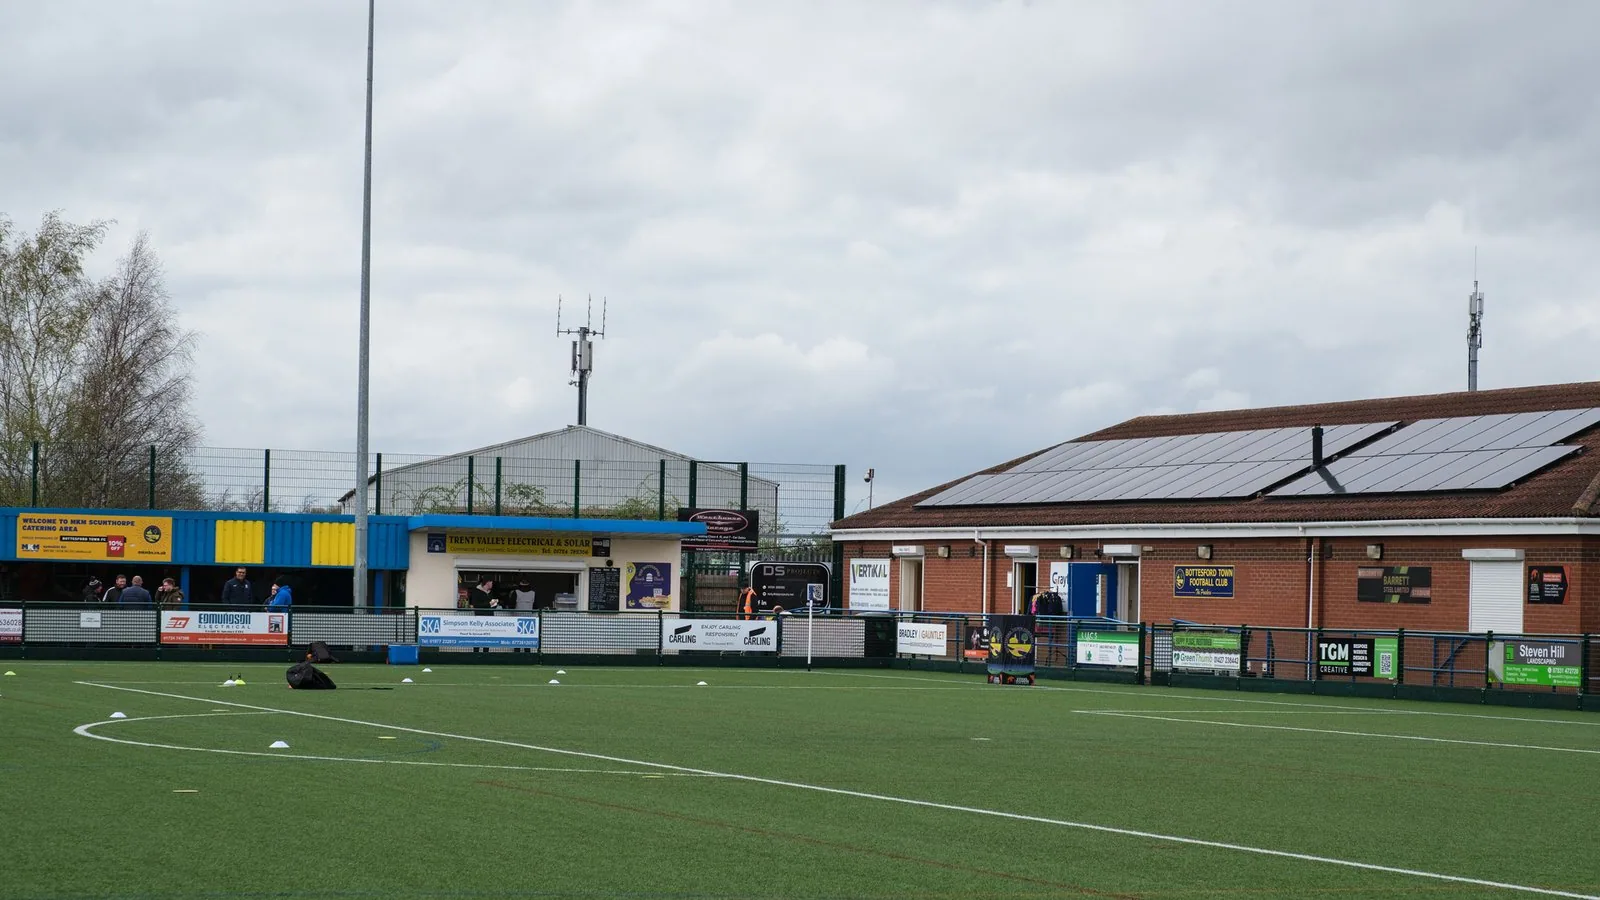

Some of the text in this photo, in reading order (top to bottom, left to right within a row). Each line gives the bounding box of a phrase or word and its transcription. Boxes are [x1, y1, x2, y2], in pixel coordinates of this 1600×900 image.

[449, 536, 475, 544] TRENT
[477, 536, 505, 545] VALLEY
[508, 537, 554, 546] ELECTRICAL
[564, 538, 590, 547] SOLAR
[763, 566, 785, 576] DS
[1185, 568, 1233, 577] BOTTESFORD TOWN
[1052, 572, 1068, 588] Gray
[1190, 578, 1228, 587] FOOTBALL CLUB
[1383, 576, 1409, 586] BARRETT
[198, 612, 251, 624] EDMUNDSON
[421, 620, 440, 633] SKA
[517, 620, 534, 634] SKA
[669, 635, 696, 643] CARLING
[899, 629, 944, 640] BRADLEY GAUNTLET
[744, 637, 770, 646] CARLING
[1320, 643, 1349, 660] TGM
[1520, 644, 1565, 658] Steven Hill
[1181, 653, 1212, 663] GreenThumb
